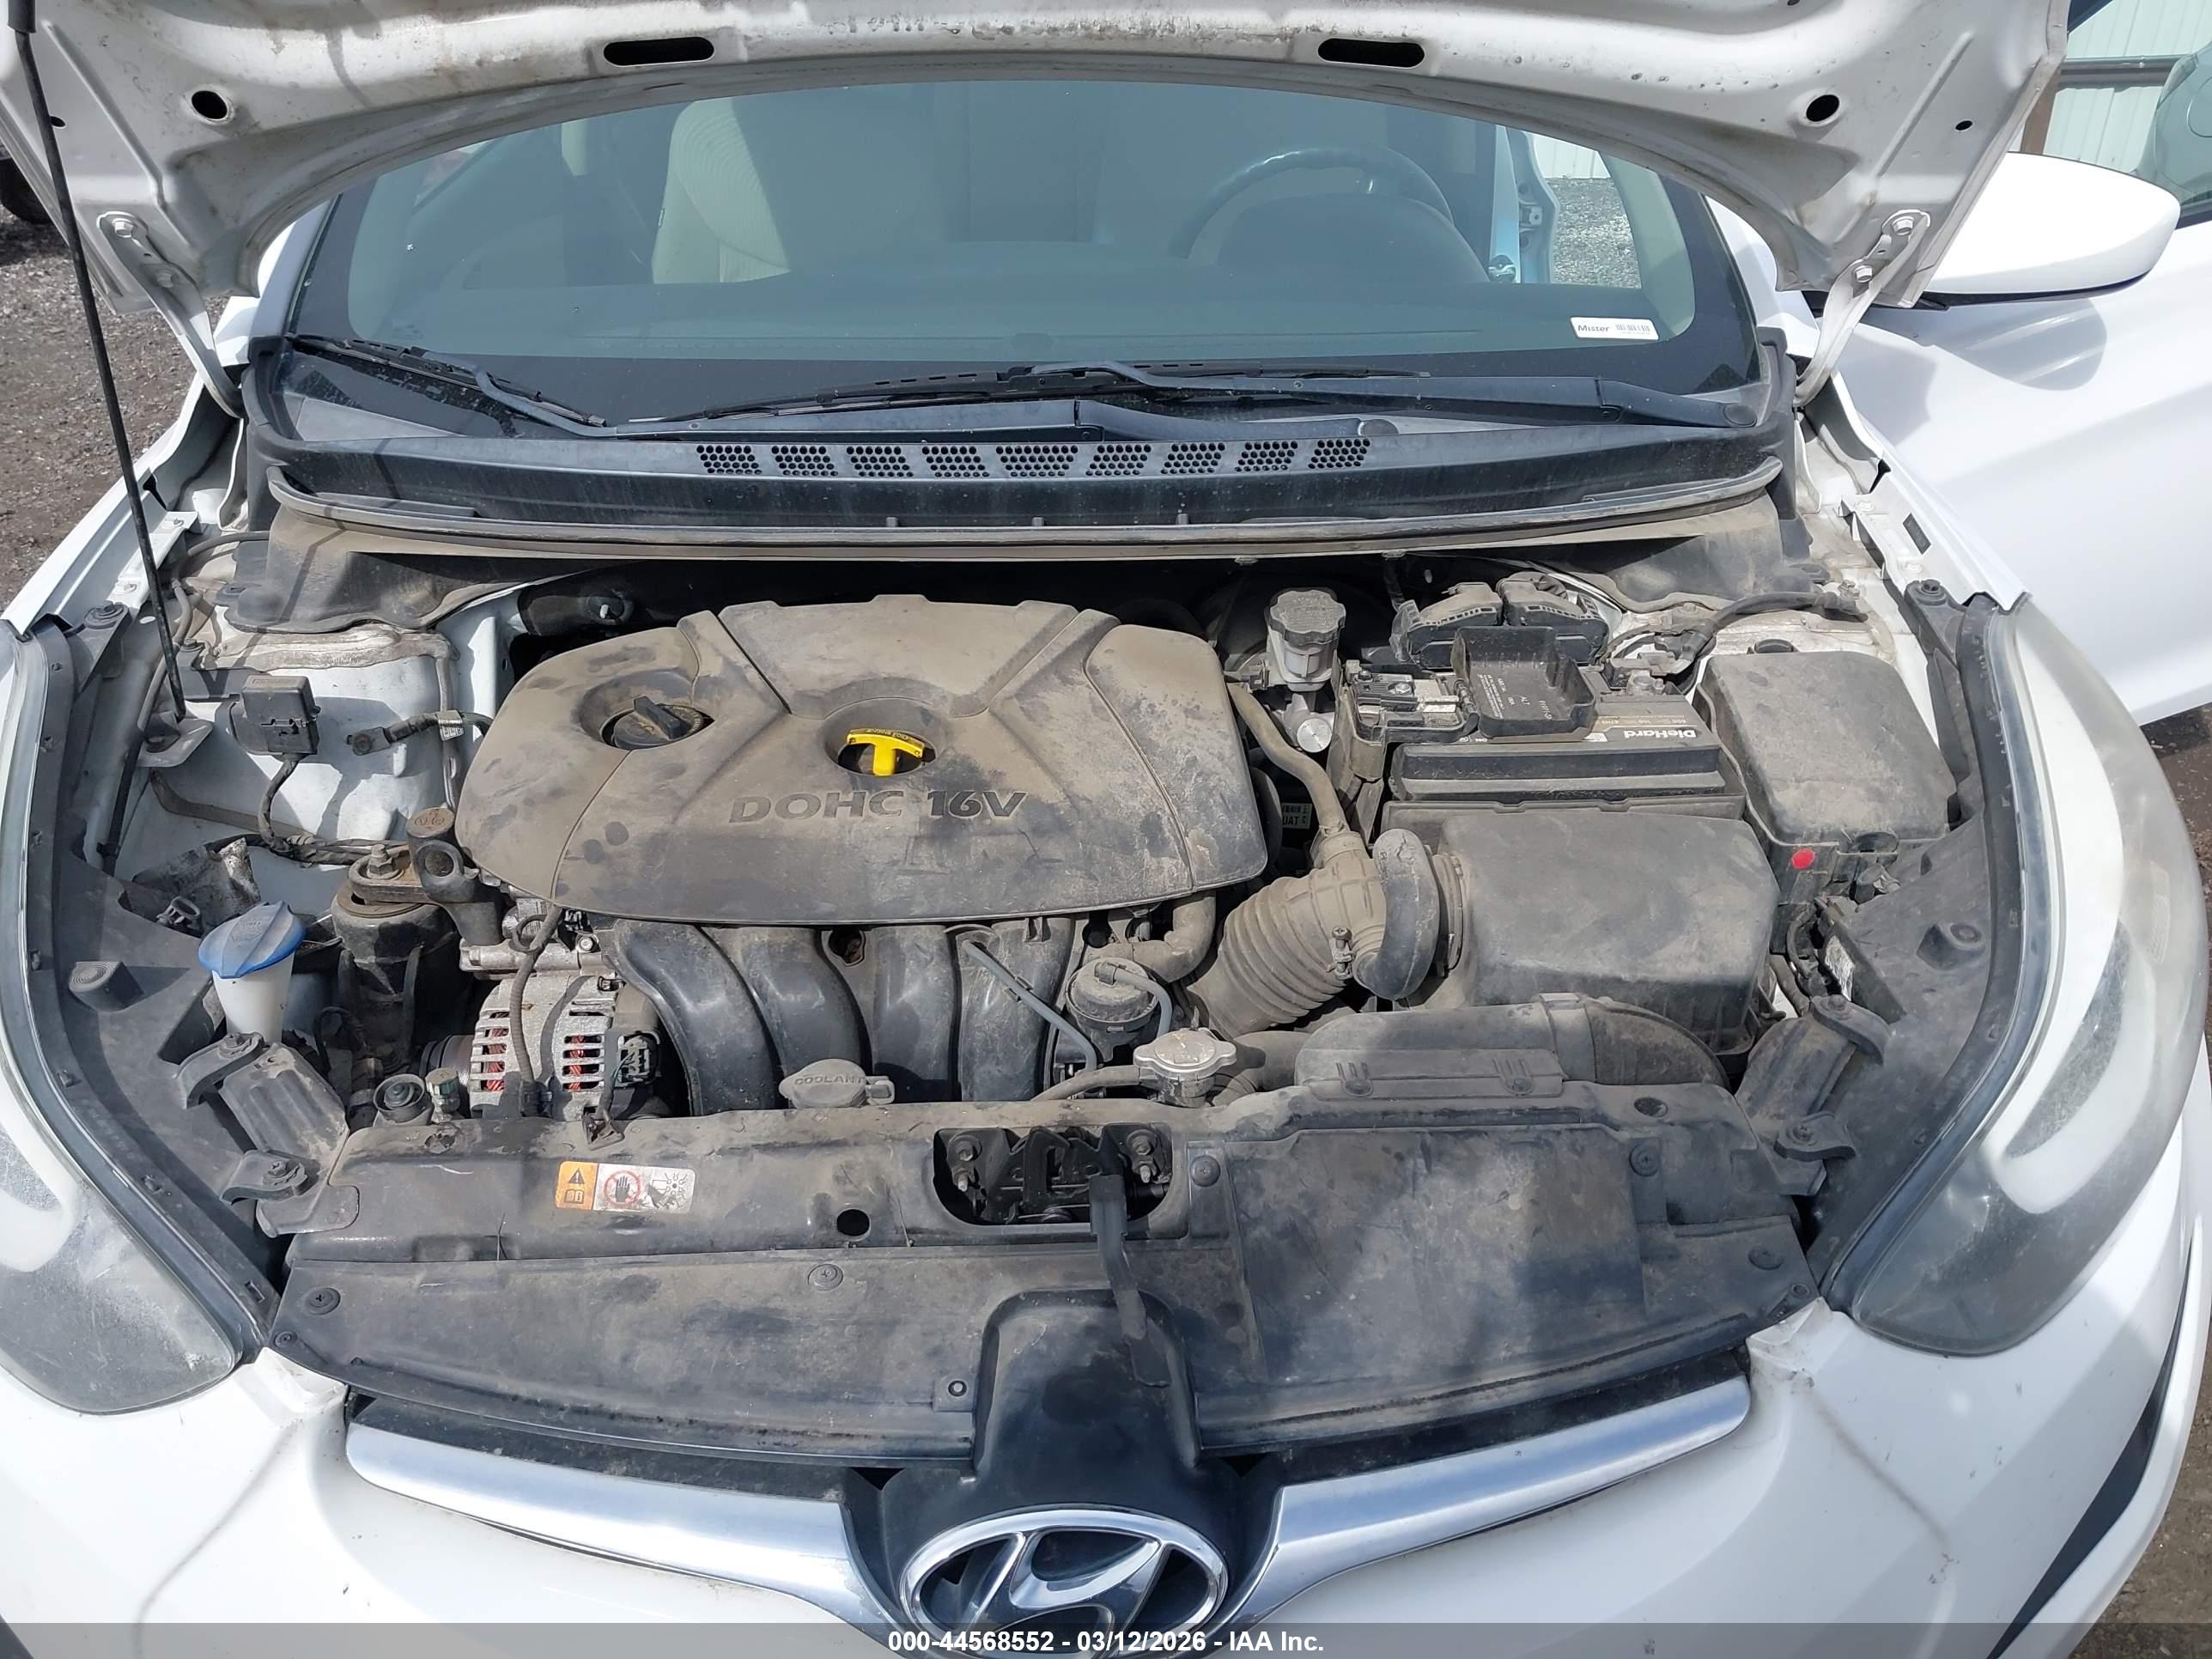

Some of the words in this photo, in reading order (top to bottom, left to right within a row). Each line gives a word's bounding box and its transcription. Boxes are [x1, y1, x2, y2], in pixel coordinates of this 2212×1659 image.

[1624, 729, 1698, 739] DieHard
[729, 790, 904, 823] DOHC
[927, 791, 1027, 818] 16V
[794, 1073, 865, 1085] COOLANT
